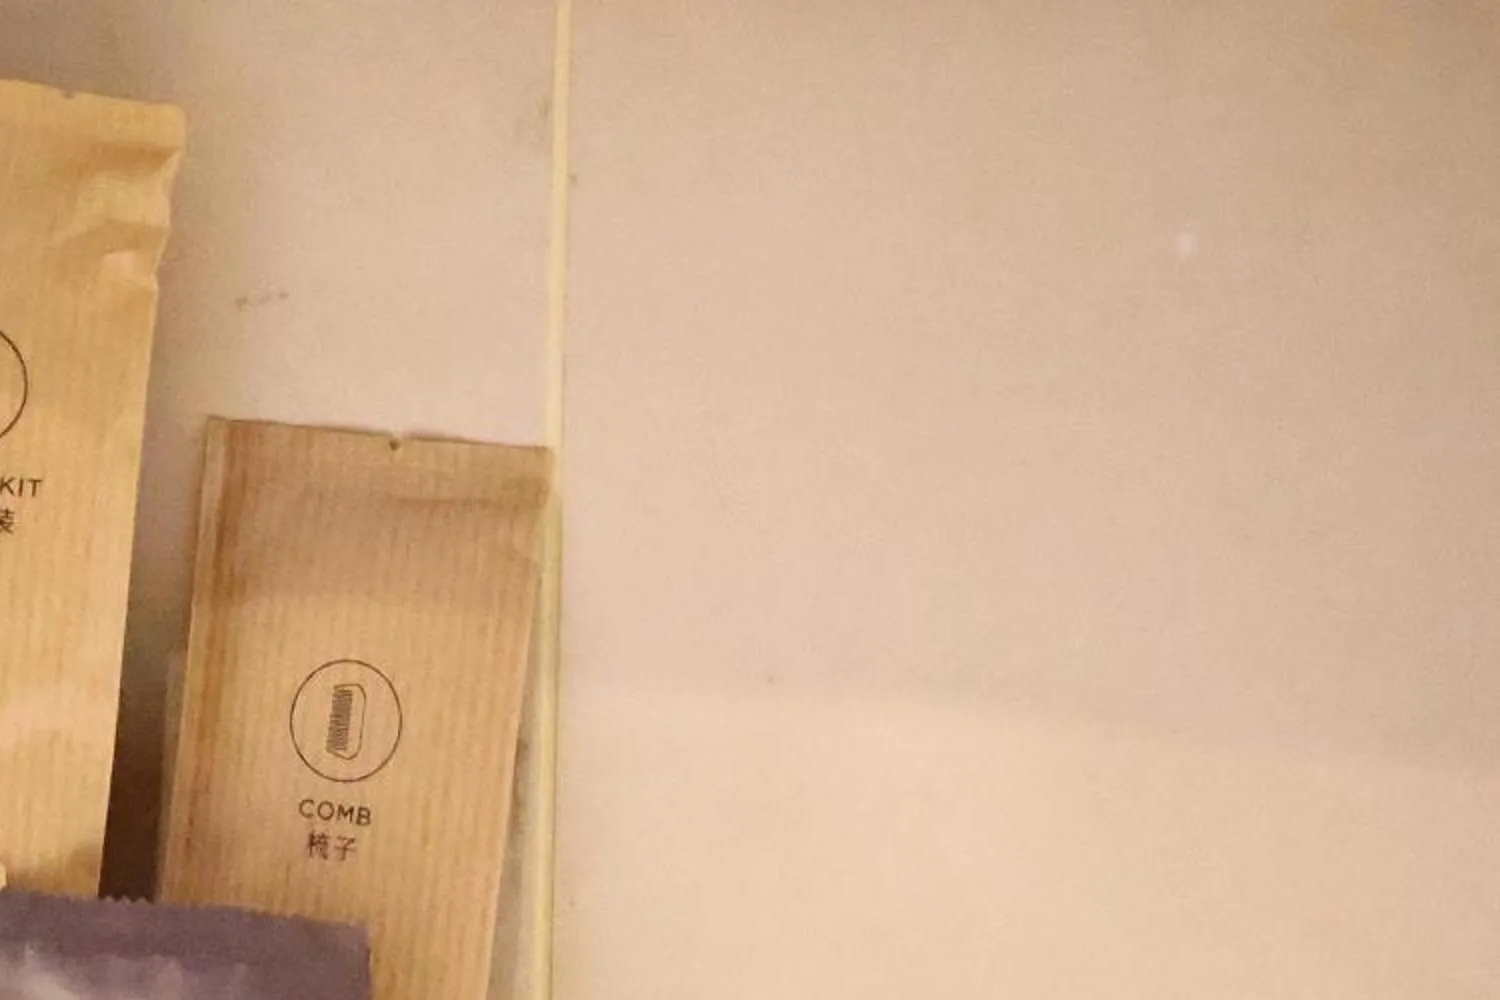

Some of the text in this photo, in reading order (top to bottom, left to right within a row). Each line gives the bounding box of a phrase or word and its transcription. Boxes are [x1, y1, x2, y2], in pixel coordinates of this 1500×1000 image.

[0, 475, 44, 499] KIT
[298, 798, 373, 826] COMB
[306, 830, 357, 862] 梳子
